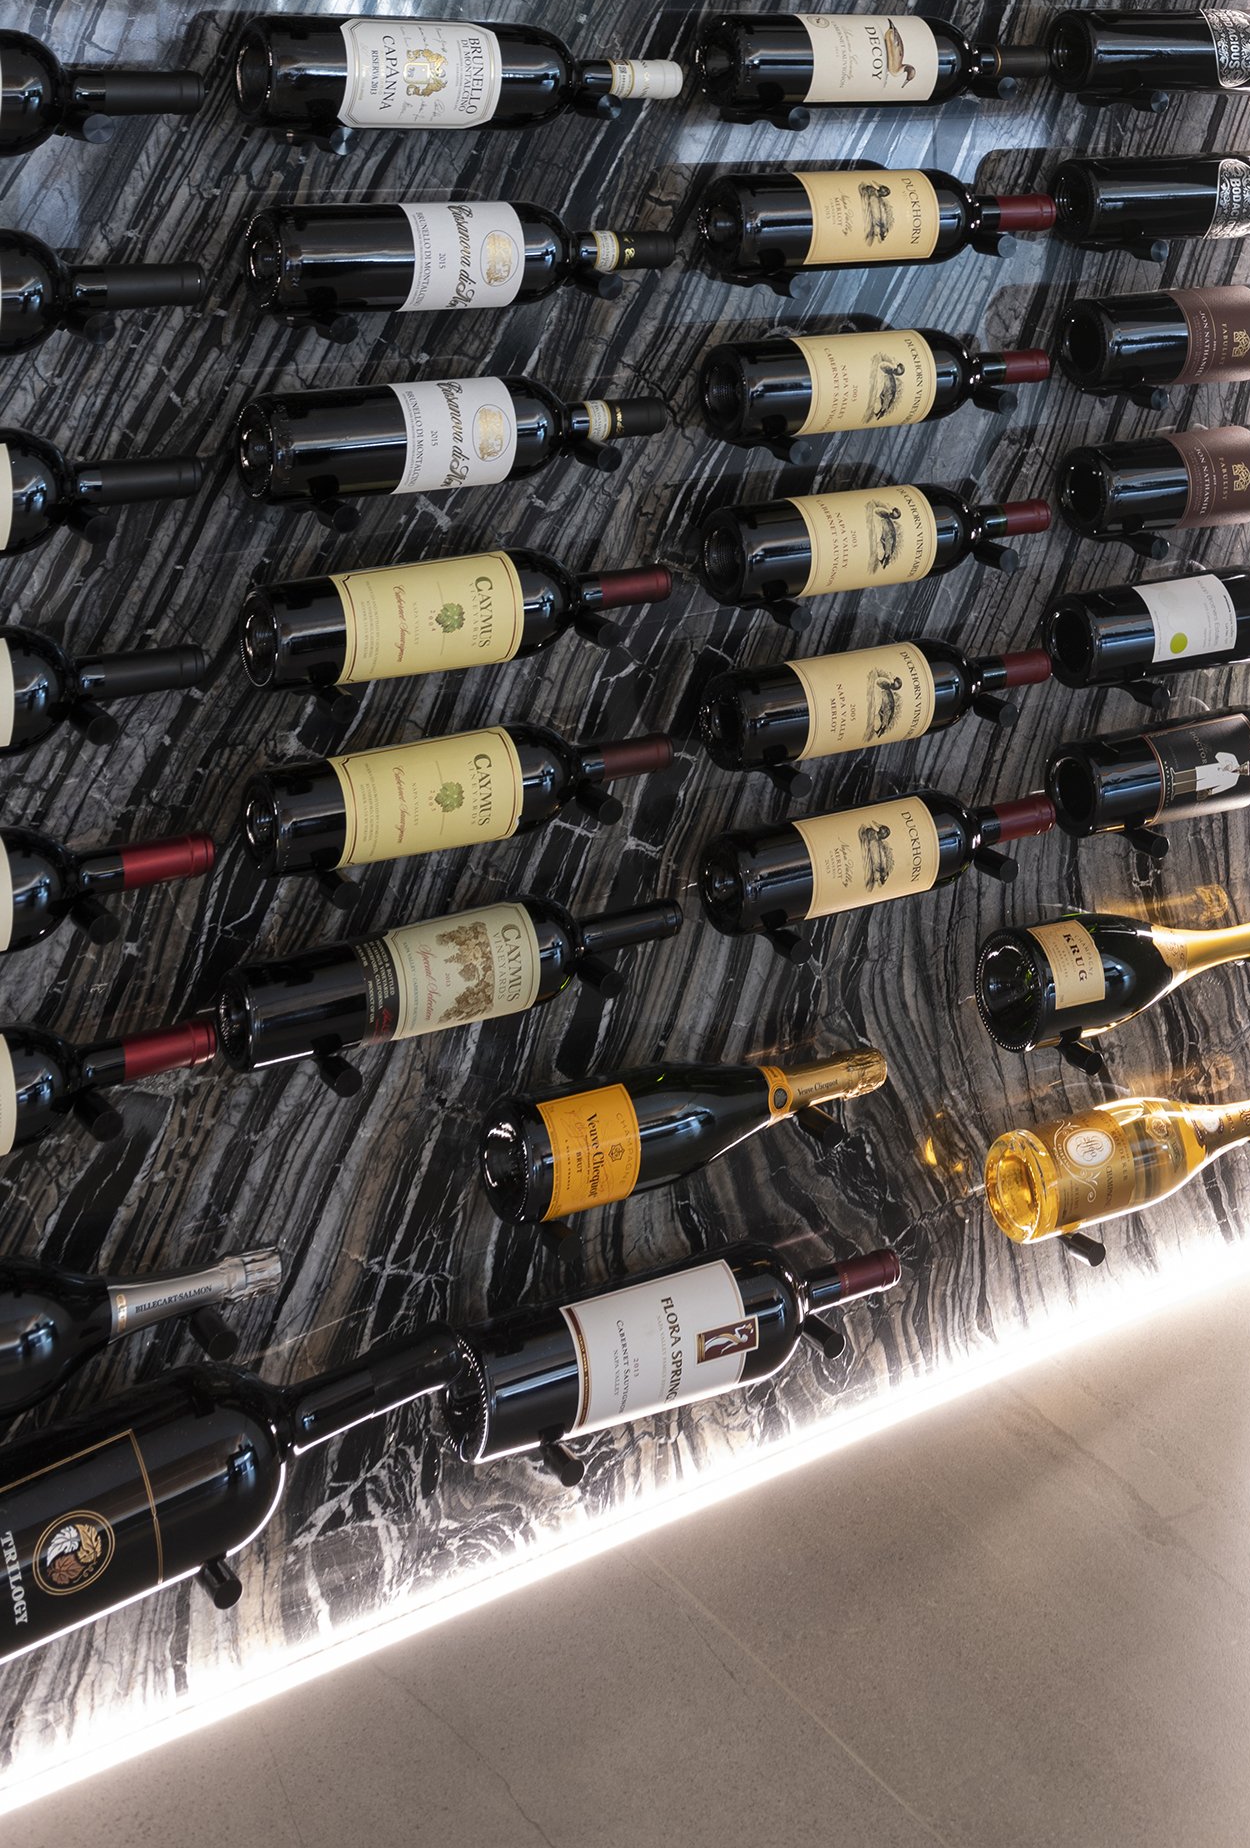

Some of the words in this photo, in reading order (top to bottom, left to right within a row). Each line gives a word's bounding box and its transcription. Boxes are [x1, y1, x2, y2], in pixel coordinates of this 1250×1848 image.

[379, 36, 398, 111] CAPANNA
[465, 37, 479, 115] BRUNELLO
[864, 26, 883, 81] DECOY
[459, 50, 469, 112] MONTALCINO
[416, 212, 432, 250] BRUNELLO
[833, 196, 843, 227] MERLOT
[901, 177, 922, 245] DUCKHORN
[447, 204, 473, 267] Casanova
[438, 253, 446, 270] 2015
[823, 348, 839, 388] CABERNET
[904, 338, 922, 388] DUCKHORN
[406, 390, 423, 432] BRUNELLO
[437, 381, 463, 443] Casanova
[837, 387, 848, 419] VALLEY
[901, 388, 923, 425] VINEYAR
[430, 430, 438, 447] 2015
[816, 499, 837, 540] CABERNET
[896, 487, 921, 527] DUCKHORN
[835, 512, 846, 530] NAPA
[841, 534, 849, 569] VALLEY
[473, 576, 493, 649] CAYMUS
[836, 683, 845, 705] NAPA
[899, 652, 921, 697] DUCKHORN
[829, 698, 837, 733] MERLOT
[838, 708, 847, 743] VALLEY
[473, 753, 491, 826] CAYMUS
[833, 848, 842, 879] MERLOT
[900, 811, 922, 883] DUCKHORN
[493, 931, 505, 1000] VINEYARDS
[500, 922, 521, 1003] CAYMUS
[1063, 933, 1088, 982] KRUG
[586, 1112, 600, 1149] Veuve
[615, 1112, 631, 1185] CHAMPAGNE
[135, 1285, 213, 1313] BILLECART-SALMON
[661, 1297, 681, 1347] FLORA
[616, 1319, 629, 1362] CABERNET
[1, 1530, 28, 1626] TRILOGY
